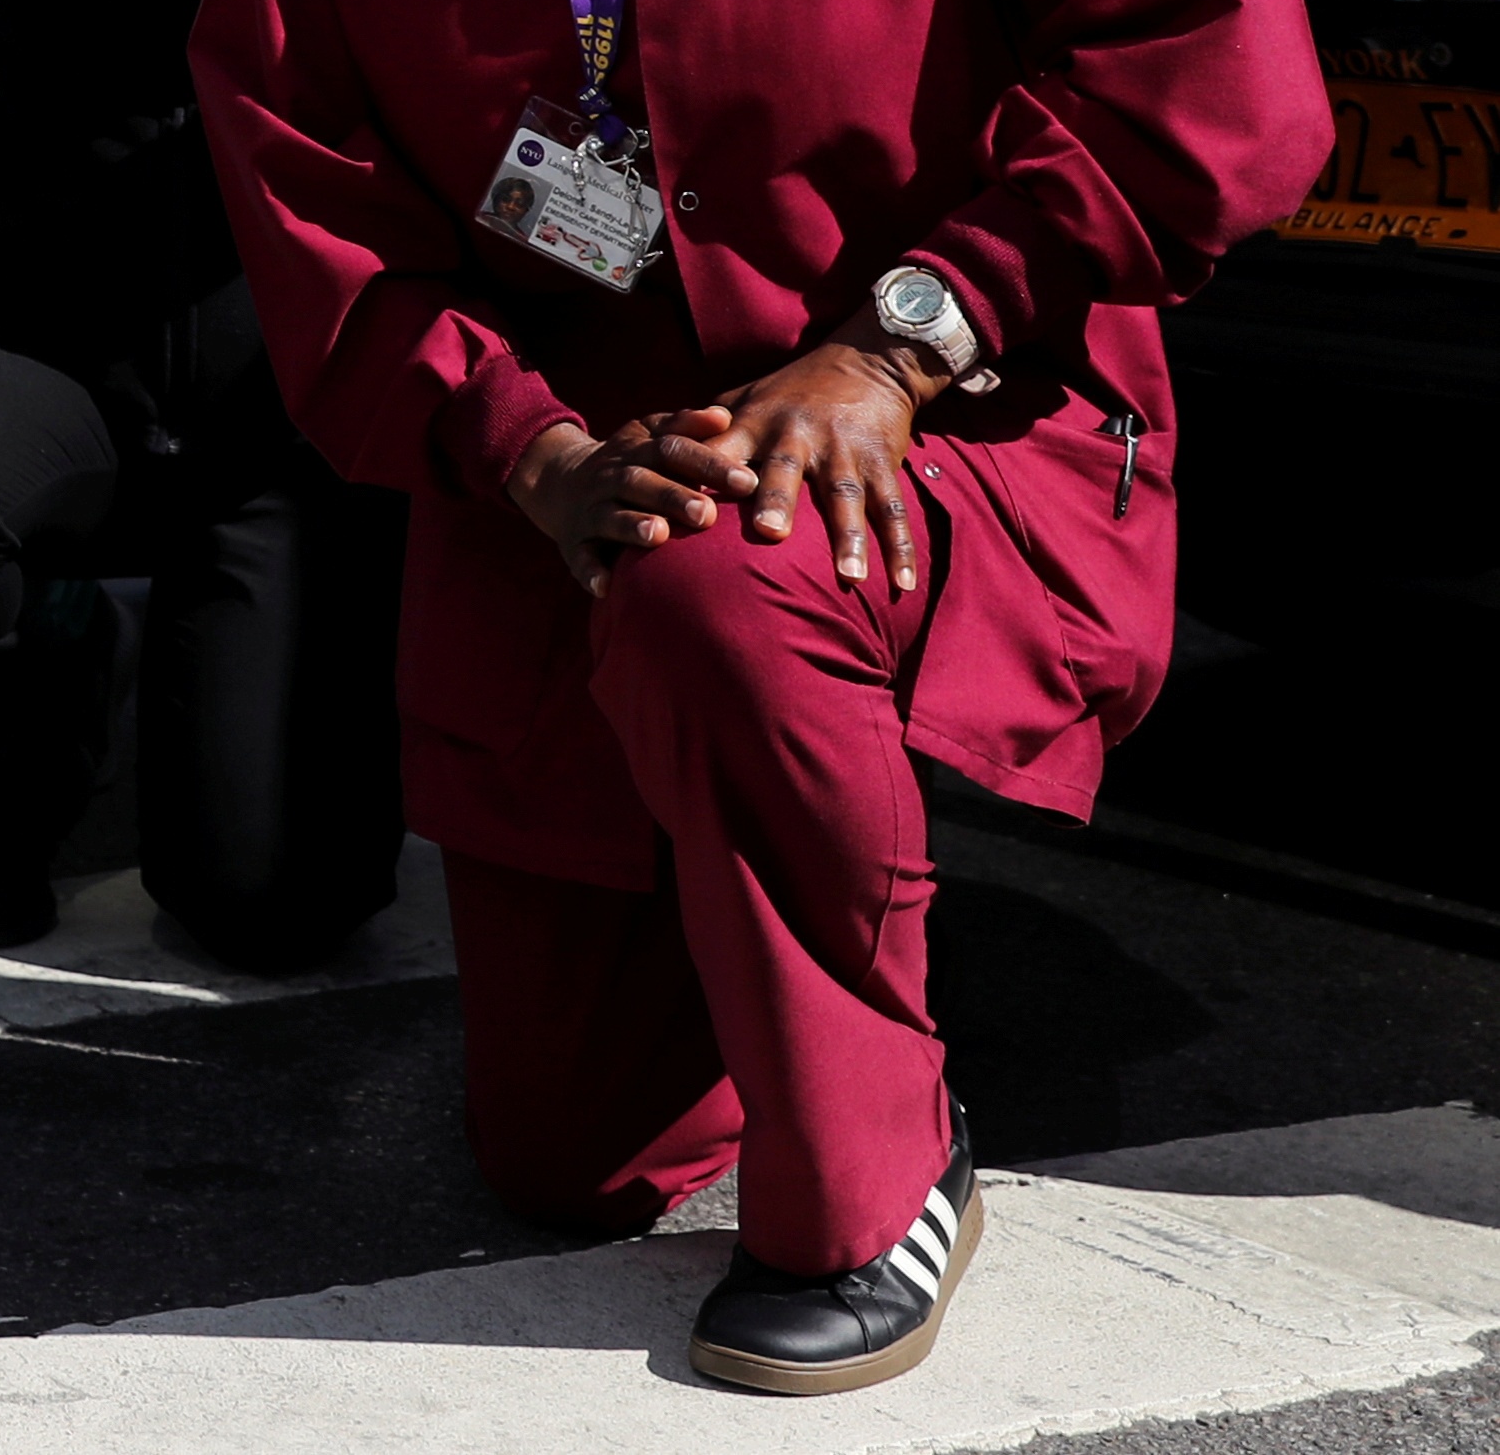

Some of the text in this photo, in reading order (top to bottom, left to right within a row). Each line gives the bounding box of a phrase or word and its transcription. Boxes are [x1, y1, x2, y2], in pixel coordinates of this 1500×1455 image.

[1321, 48, 1431, 80] YORK
[520, 146, 543, 160] NYU
[545, 206, 589, 231] EMERGENCY
